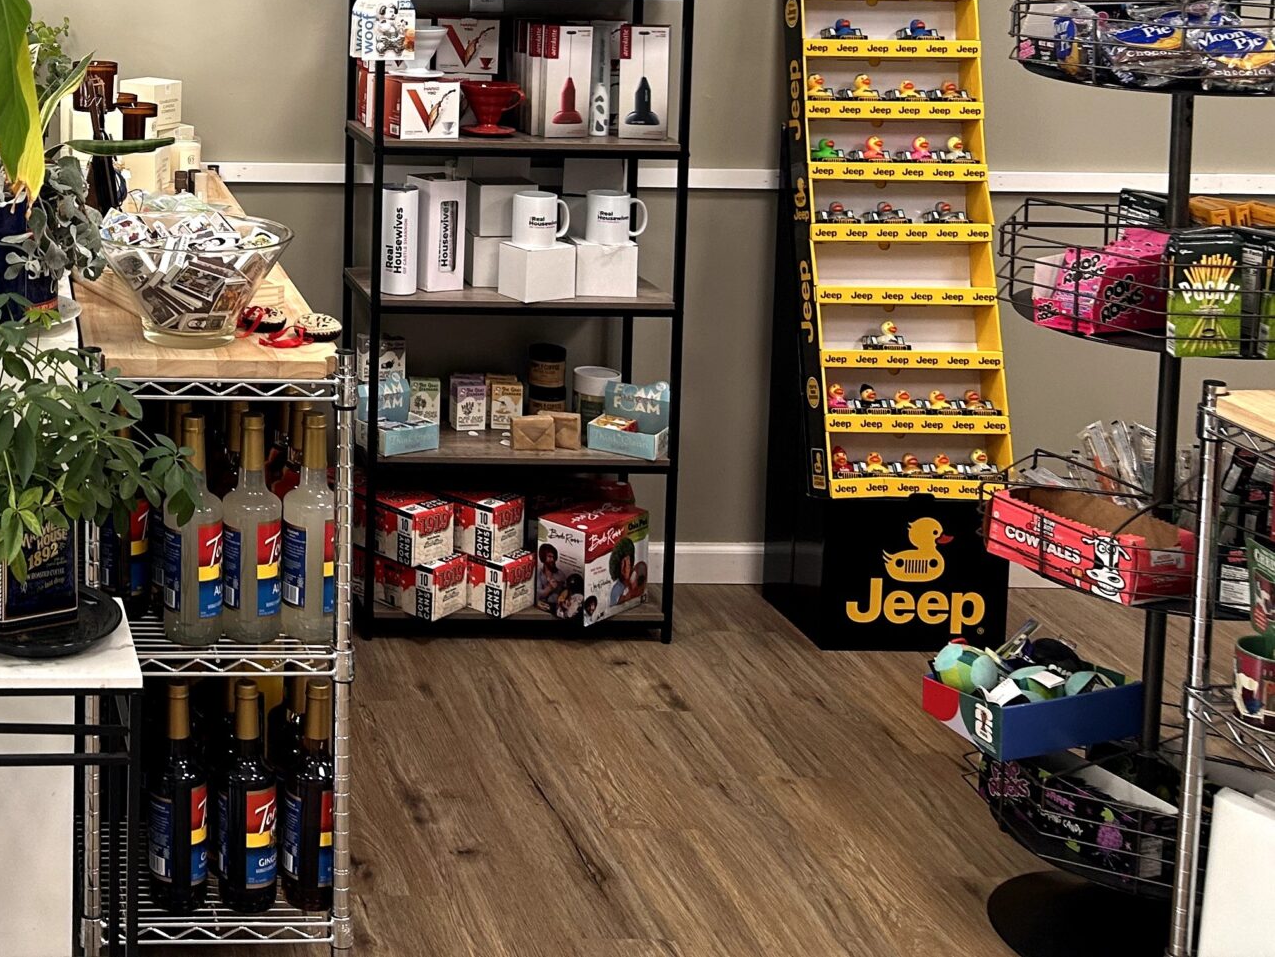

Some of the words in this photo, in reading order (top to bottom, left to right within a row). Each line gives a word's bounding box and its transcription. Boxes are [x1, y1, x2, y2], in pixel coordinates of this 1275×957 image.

[364, 14, 376, 54] woof
[1142, 25, 1172, 38] Pie
[1197, 29, 1246, 48] Moon
[1234, 35, 1264, 50] Pie
[789, 59, 801, 141] Jeep
[393, 207, 404, 274] Housewives
[815, 227, 838, 238] Jeep
[845, 228, 868, 239] Jeep
[876, 228, 899, 239] Jeep
[905, 228, 928, 239] Jeep
[936, 229, 959, 240] Jeep
[967, 229, 990, 240] Jeep
[385, 244, 394, 270] Real
[799, 259, 814, 343] Jeep
[1178, 280, 1241, 305] Pocky
[829, 419, 852, 430] Jeep
[418, 511, 451, 538] 1919
[480, 511, 488, 525] 10
[498, 507, 523, 531] 1919
[37, 527, 68, 551] HOUSE
[483, 531, 491, 559] CANS
[547, 527, 565, 541] Bob
[564, 532, 581, 546] Ross
[587, 531, 608, 552] Bob
[607, 526, 625, 545] Ross
[1004, 525, 1040, 548] COW
[27, 542, 59, 571] 1892
[1041, 539, 1082, 565] TALES
[490, 570, 498, 584] 10
[509, 562, 536, 589] 1919
[486, 587, 494, 615] PONY
[493, 589, 501, 617] CANS
[845, 577, 986, 634] Jeep
